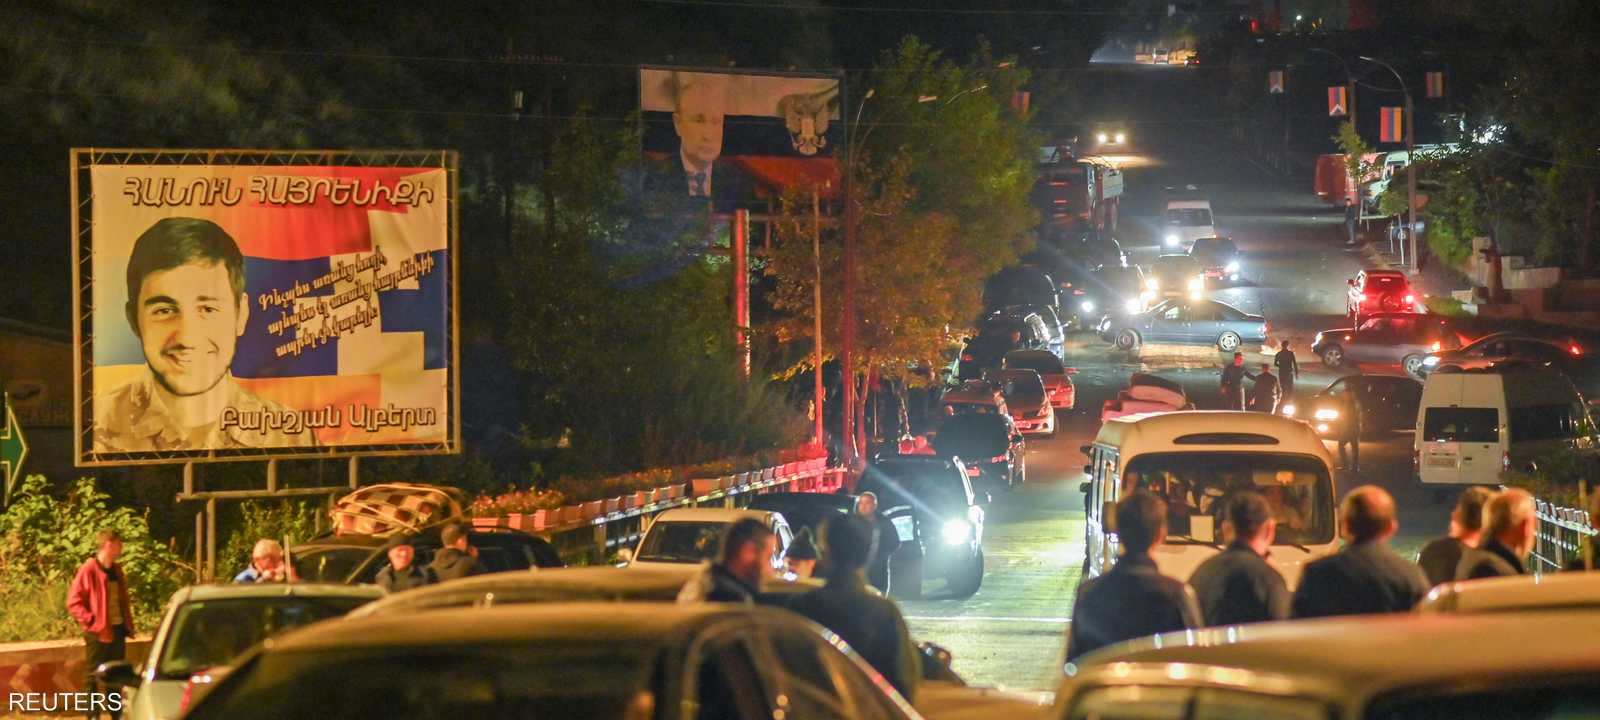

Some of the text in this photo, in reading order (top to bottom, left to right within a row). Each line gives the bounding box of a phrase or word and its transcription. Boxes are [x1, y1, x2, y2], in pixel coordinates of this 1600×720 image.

[123, 176, 434, 207] ՀԱՆՈՒՆ ՀԱՅՐԵՆԻՔԻ
[349, 402, 436, 431] Ալբերտ
